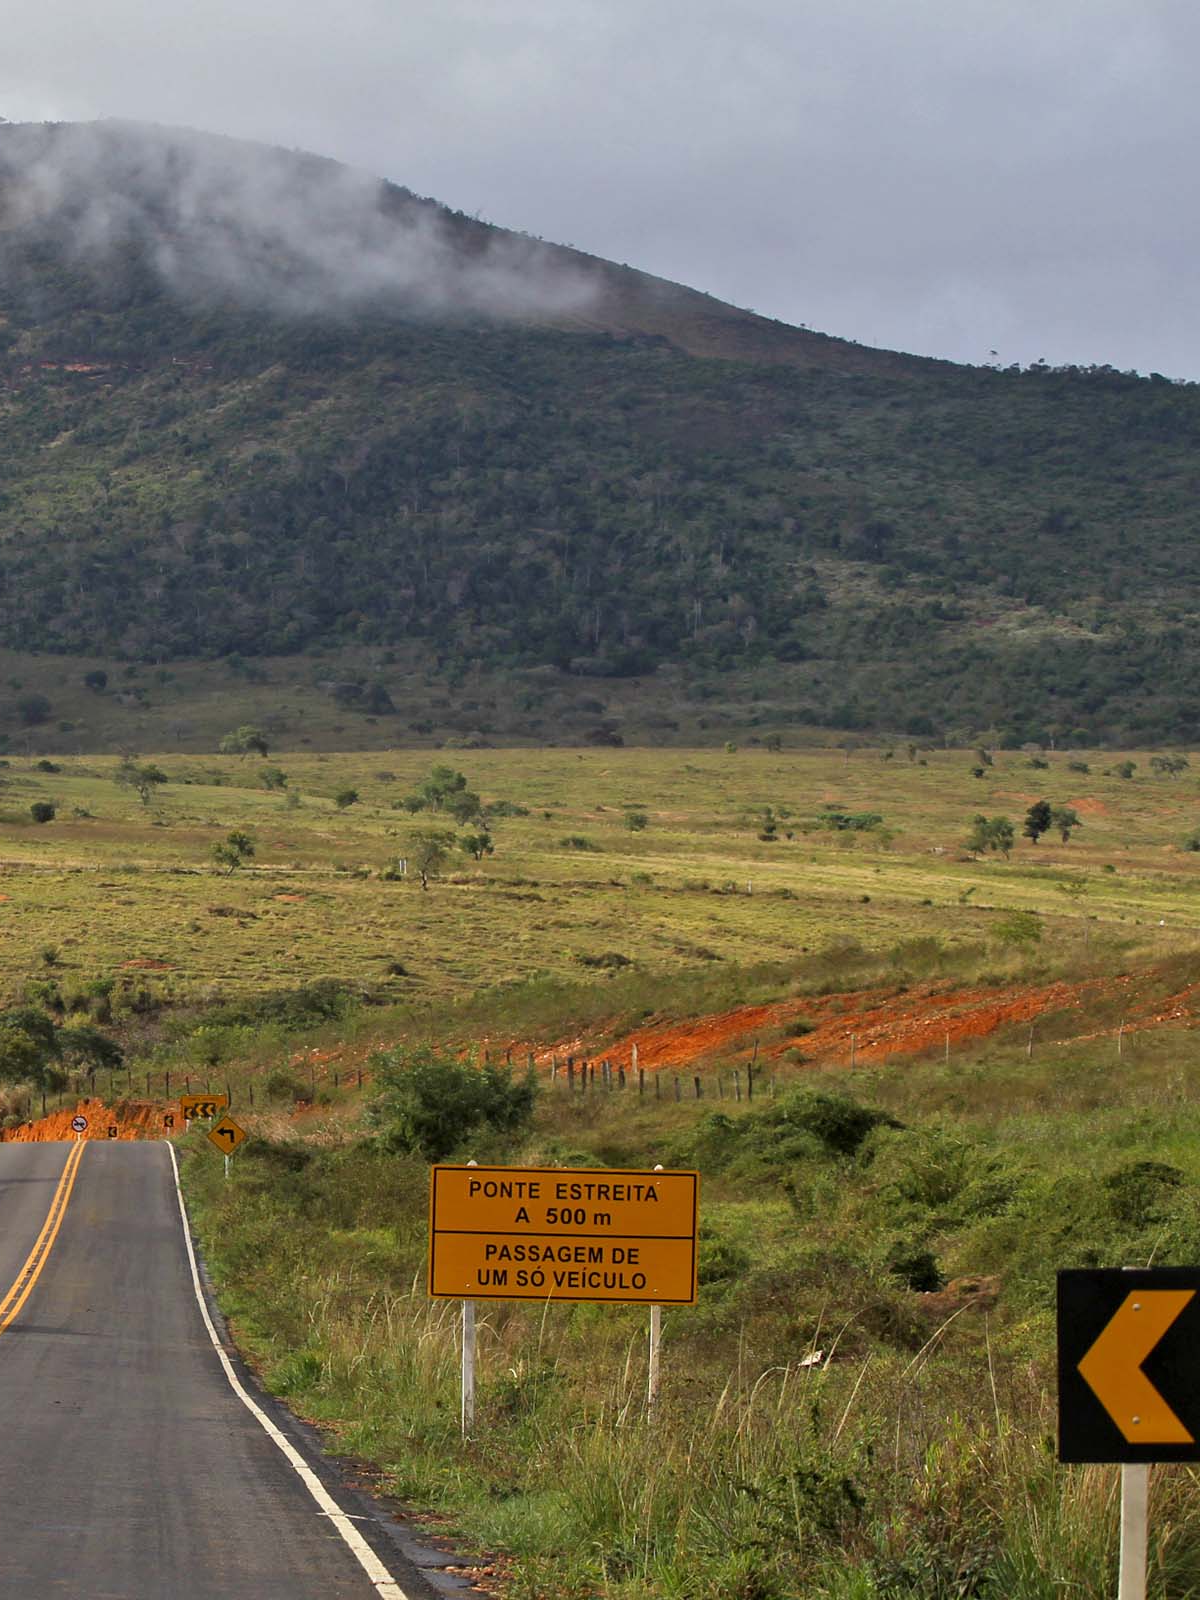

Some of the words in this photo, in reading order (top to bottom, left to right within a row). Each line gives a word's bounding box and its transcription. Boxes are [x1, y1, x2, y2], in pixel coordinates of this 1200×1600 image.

[469, 1180, 541, 1200] PONTE
[555, 1183, 659, 1202] ESTREITA
[514, 1207, 530, 1223] A
[545, 1207, 586, 1225] 500
[593, 1211, 611, 1225] m
[484, 1244, 604, 1264] PASSAGEM
[611, 1247, 640, 1265] DE
[477, 1268, 509, 1287] UM
[516, 1265, 545, 1288] SÓ
[552, 1267, 647, 1289] VEÍCULO
